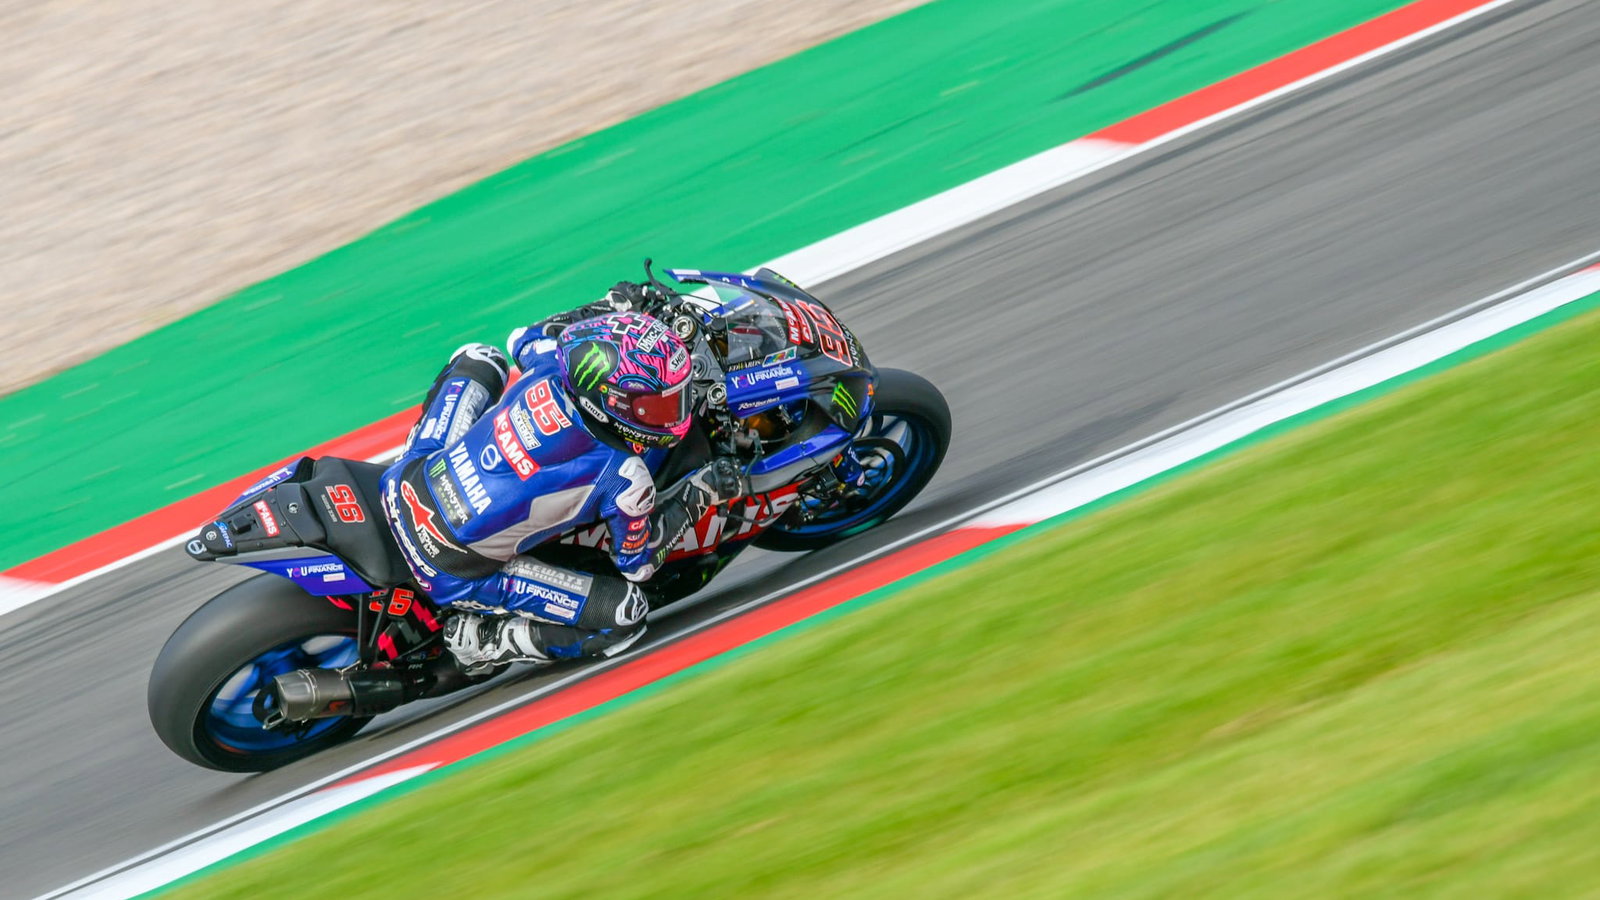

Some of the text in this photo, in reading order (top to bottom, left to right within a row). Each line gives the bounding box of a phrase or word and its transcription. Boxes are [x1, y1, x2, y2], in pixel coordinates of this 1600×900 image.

[731, 372, 756, 389] YOU
[755, 367, 793, 382] FINANCE
[445, 381, 465, 401] YOU
[525, 379, 572, 436] 95
[584, 400, 605, 421] SHOEI
[496, 412, 534, 475] McAMS
[613, 421, 660, 442] MONSTER
[449, 441, 492, 515] YAMAHA
[325, 484, 366, 523] 95
[440, 474, 468, 524] MONSTER
[561, 493, 800, 552] MAMS
[286, 563, 344, 578] YOU FINANCE
[503, 577, 526, 594] YOU
[526, 585, 579, 609] FINANCE
